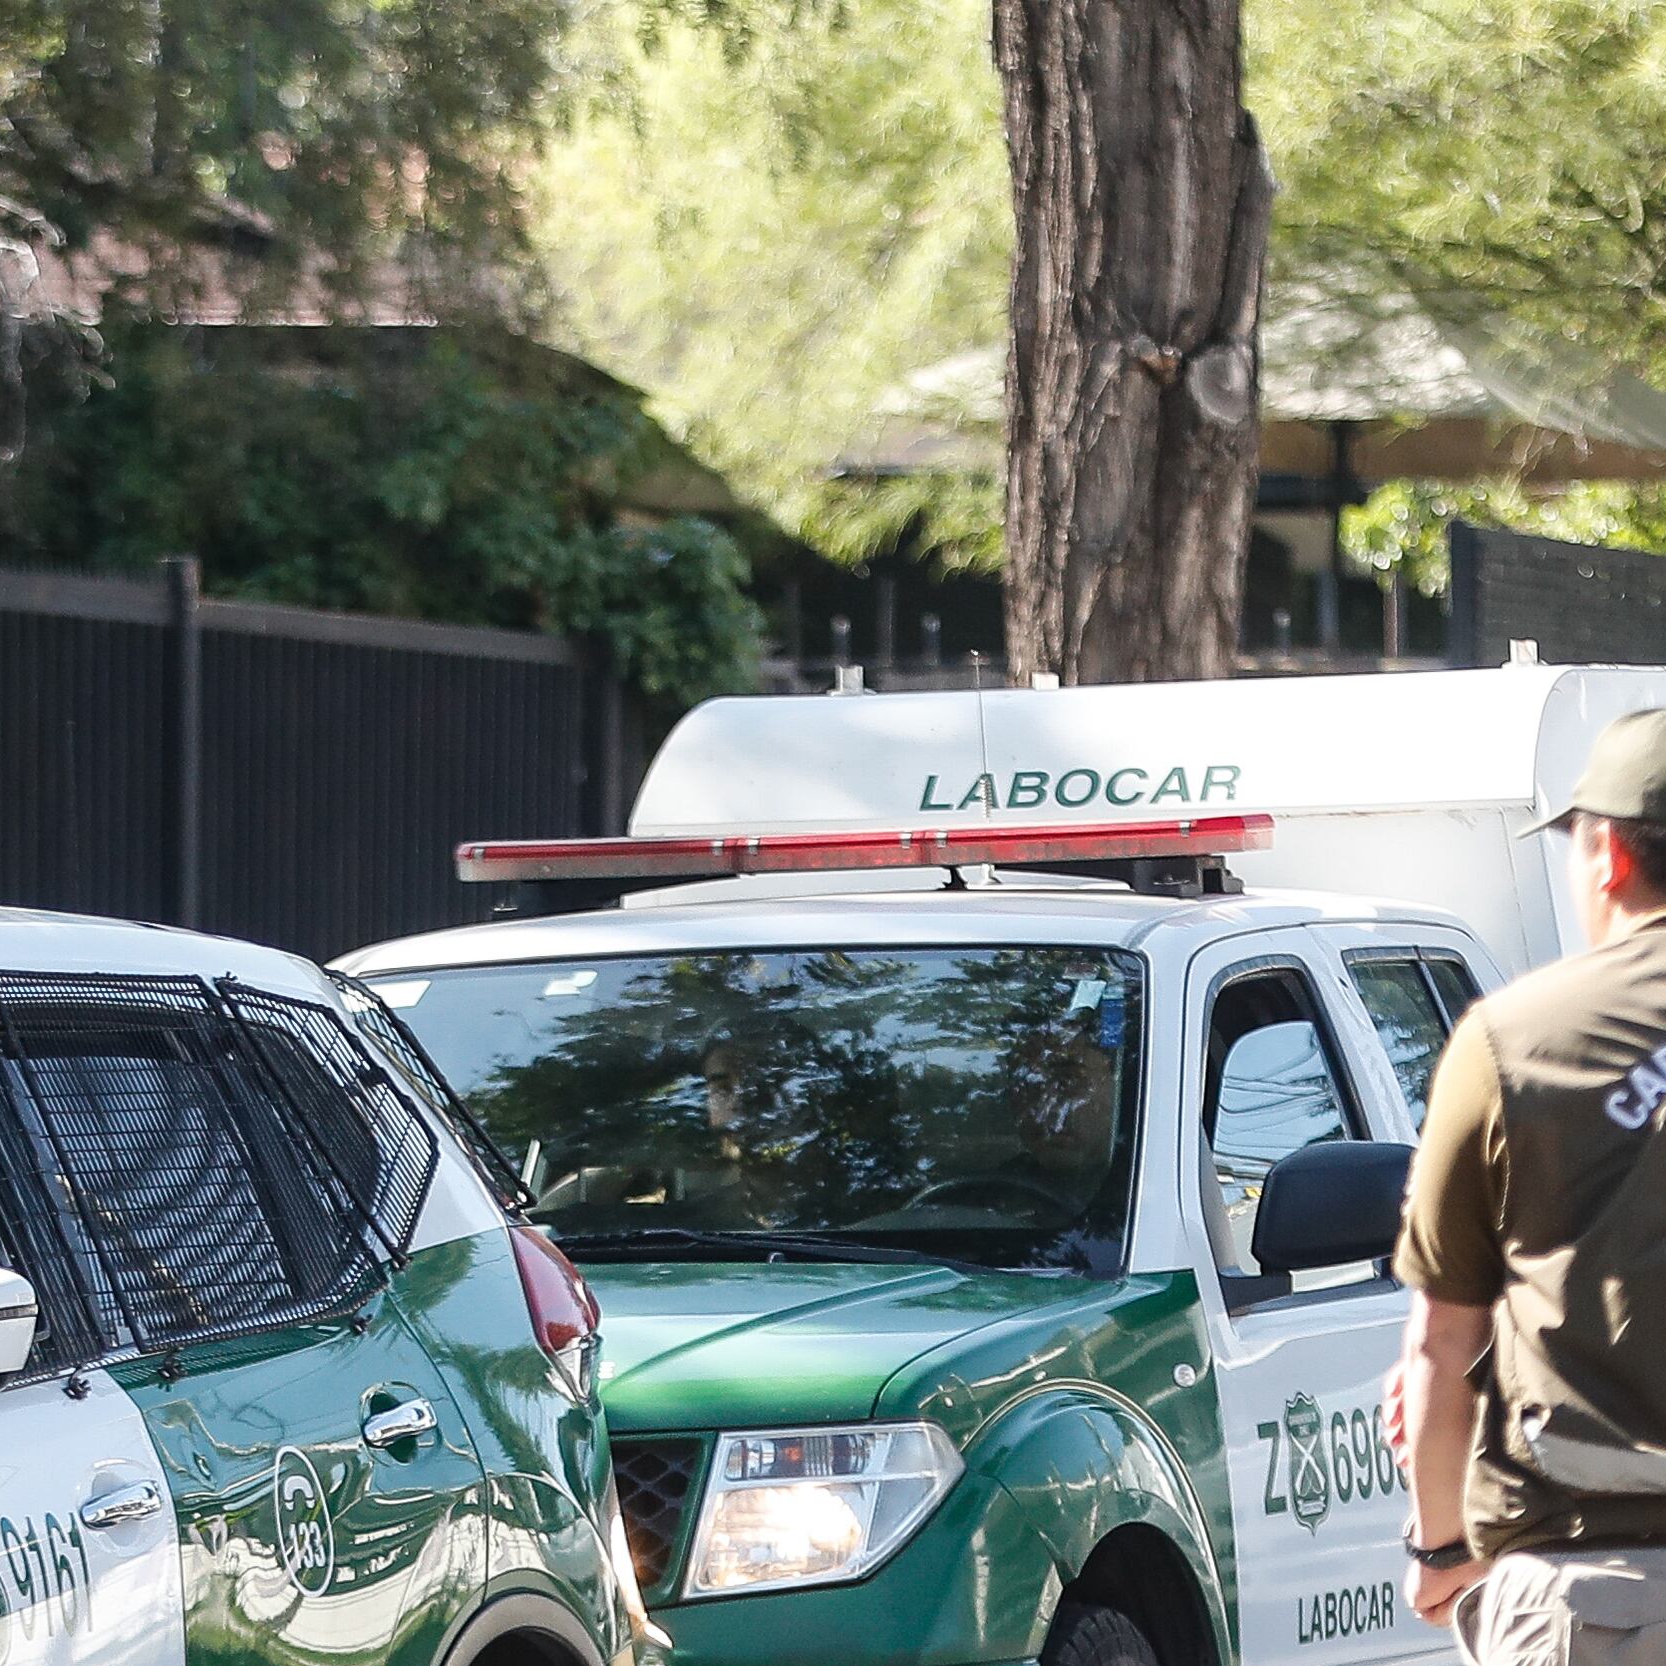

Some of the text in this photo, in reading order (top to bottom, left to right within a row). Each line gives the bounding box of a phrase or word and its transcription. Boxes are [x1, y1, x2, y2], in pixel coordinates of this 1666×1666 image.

[919, 765, 1242, 811] LABOCAR
[1257, 1404, 1409, 1515] Z 696
[0, 1512, 93, 1641] 9161
[289, 1521, 326, 1569] 133
[1298, 1581, 1395, 1645] LABOCAR
